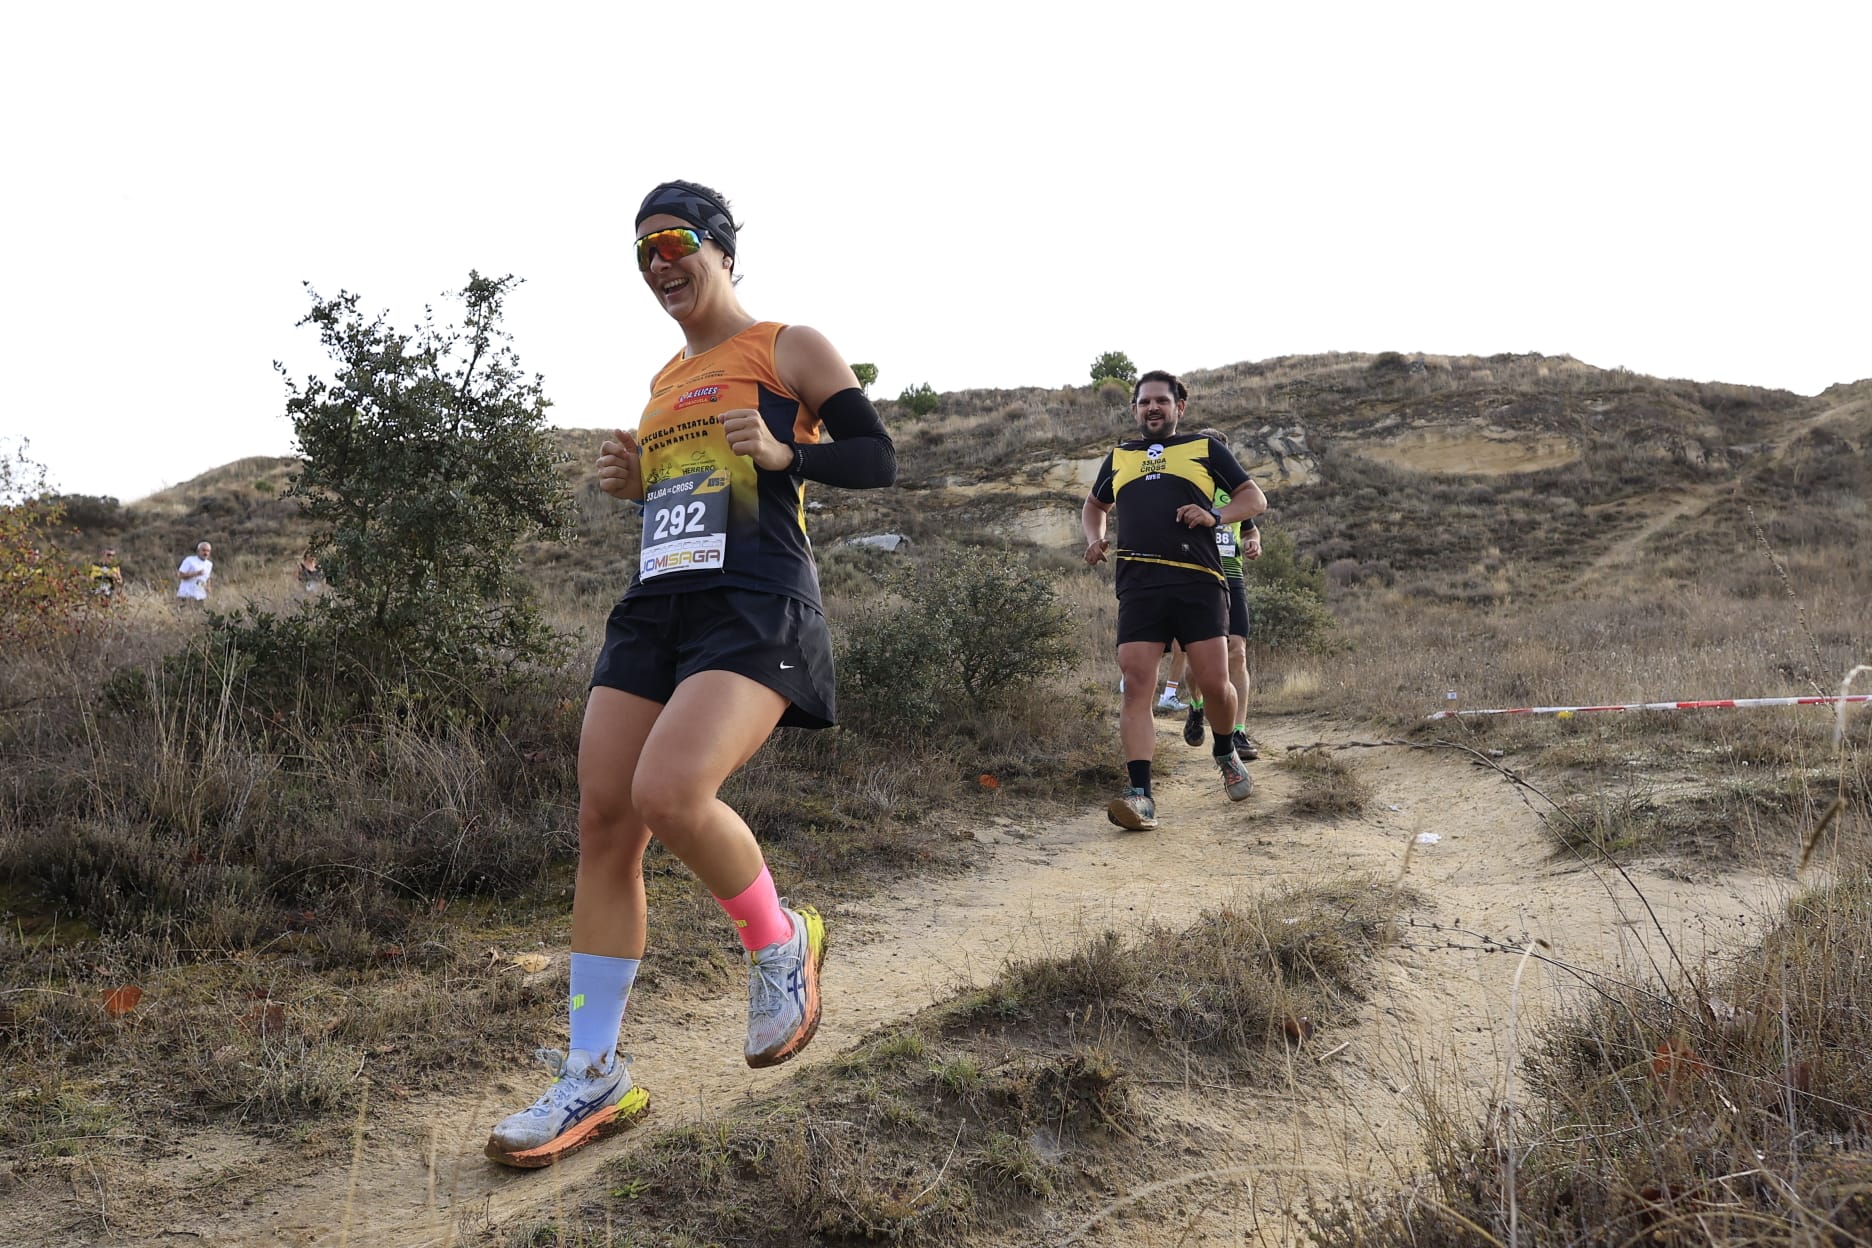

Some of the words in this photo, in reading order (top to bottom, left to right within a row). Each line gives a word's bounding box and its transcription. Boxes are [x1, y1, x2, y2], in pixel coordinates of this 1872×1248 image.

[641, 427, 675, 446] ESCUELA
[648, 430, 708, 453] SALMANTINA
[682, 465, 716, 476] HERRERO
[1140, 465, 1166, 473] CROSS
[654, 487, 667, 499] LIGA
[672, 481, 694, 494] CROSS
[653, 501, 706, 540] 292
[641, 549, 720, 574] JOMISAGA
